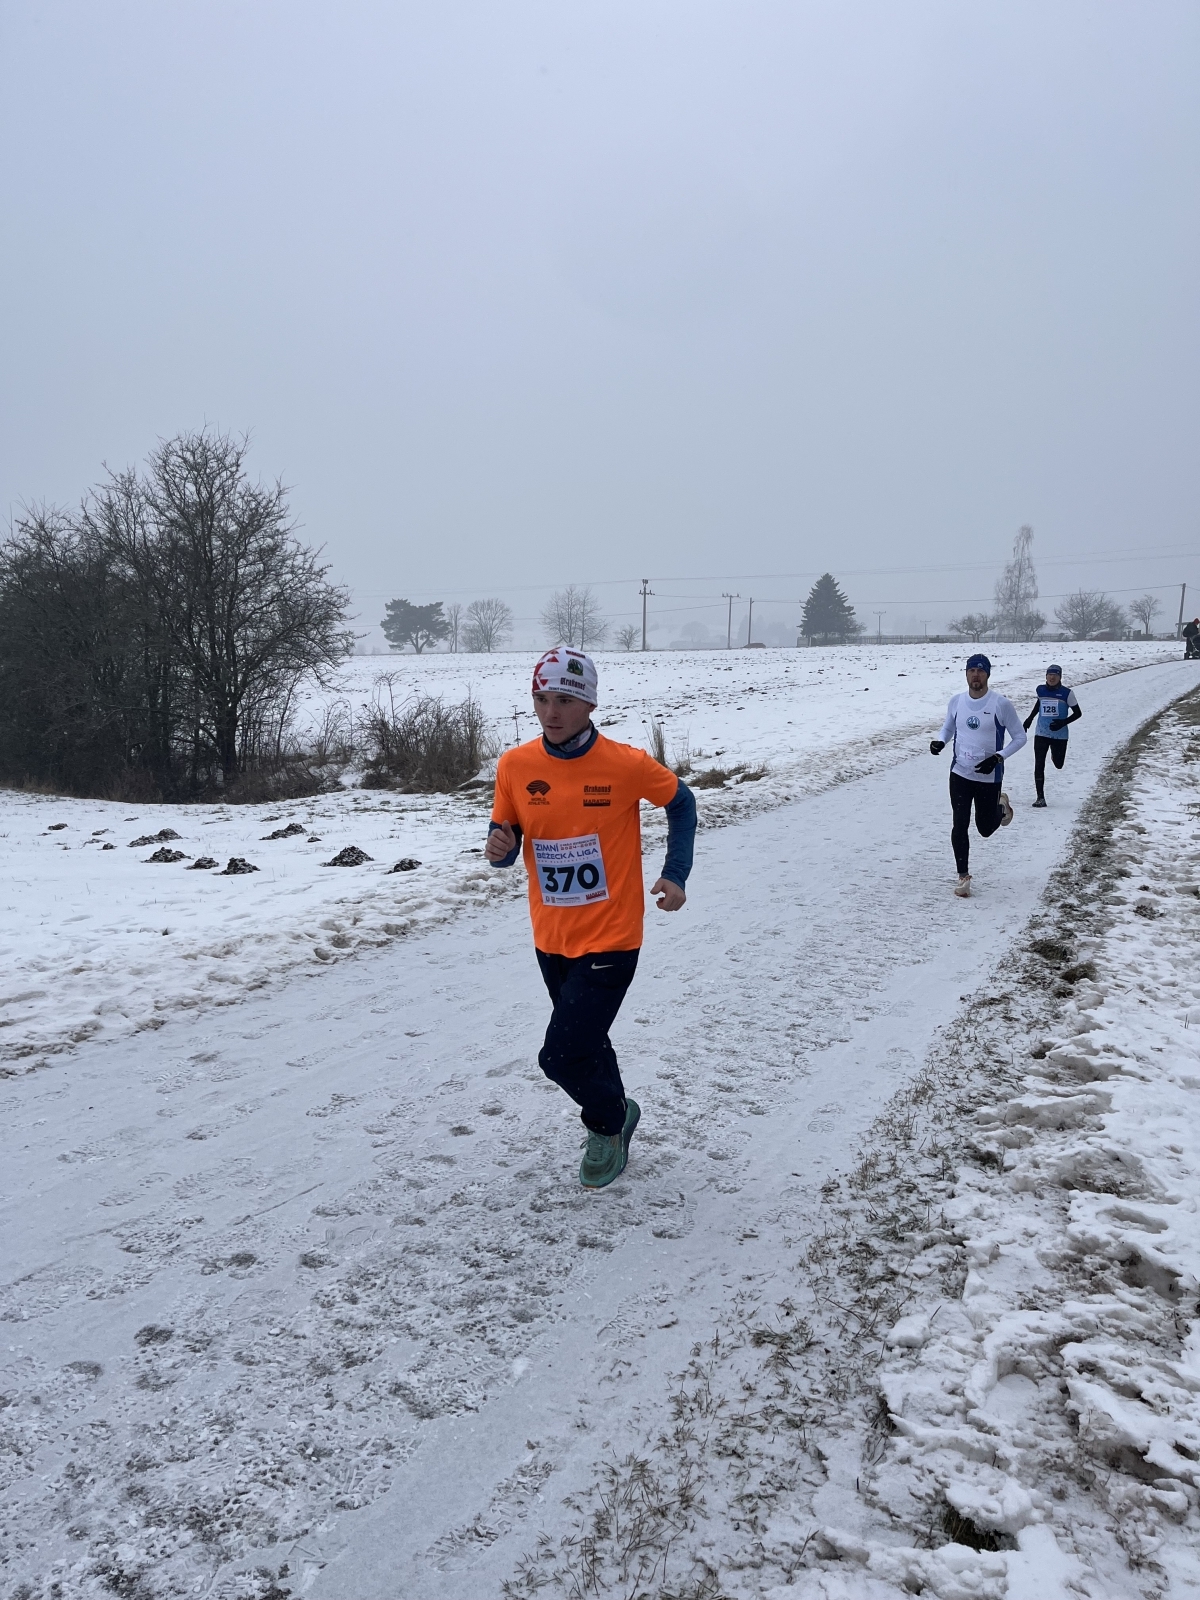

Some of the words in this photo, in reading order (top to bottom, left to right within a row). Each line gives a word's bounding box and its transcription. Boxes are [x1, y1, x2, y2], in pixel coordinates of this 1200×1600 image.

[535, 843, 559, 852] ZIMNÍ
[576, 847, 599, 857] LIGA
[541, 863, 600, 893] 370
